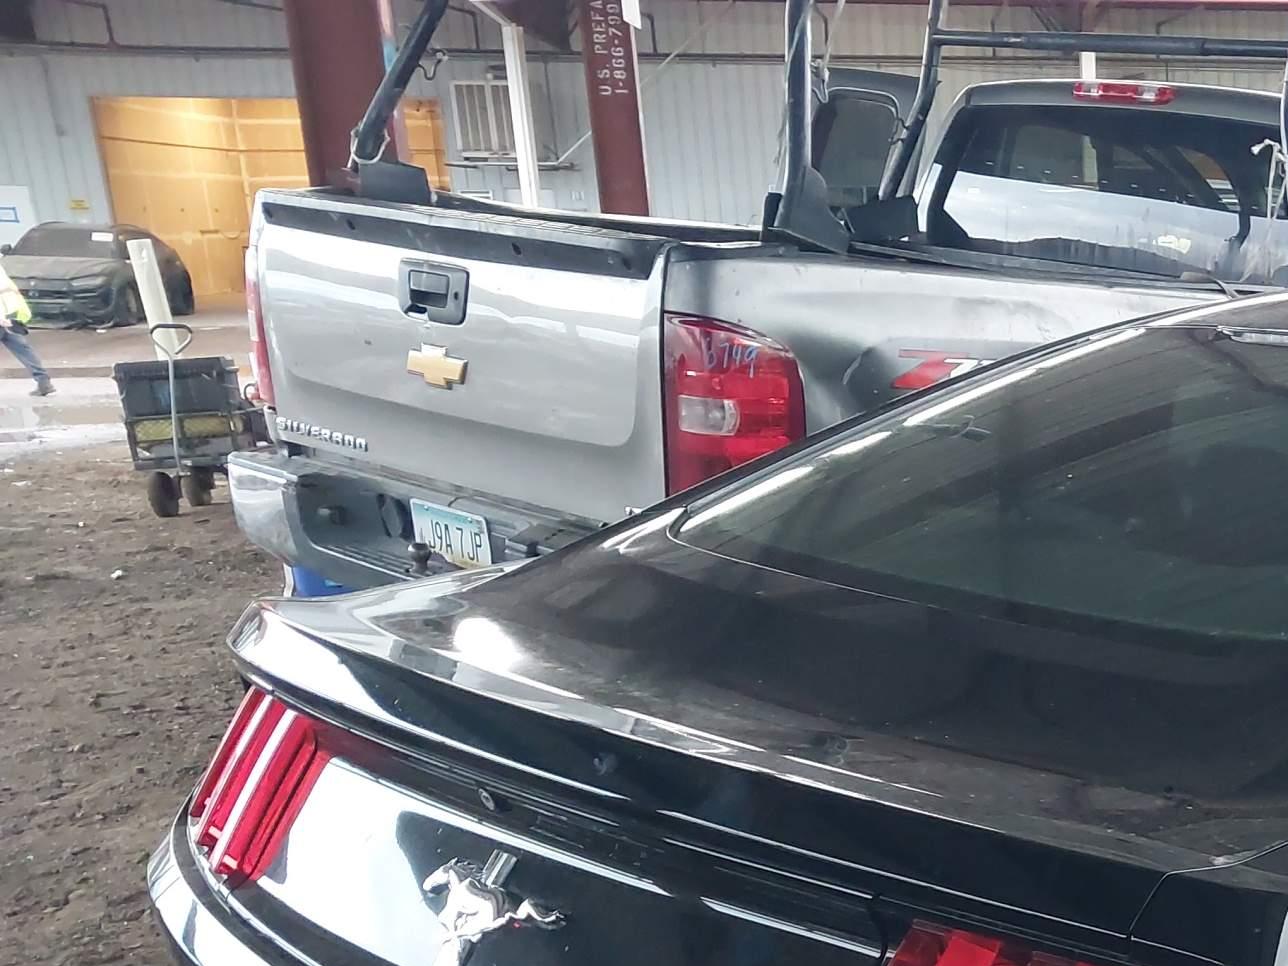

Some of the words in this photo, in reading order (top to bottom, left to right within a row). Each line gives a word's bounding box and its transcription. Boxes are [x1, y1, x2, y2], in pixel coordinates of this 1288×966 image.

[597, 63, 613, 96] U.S.
[276, 416, 369, 453] SILVERADO
[428, 519, 454, 555] J9A
[455, 526, 483, 562] 7JP
